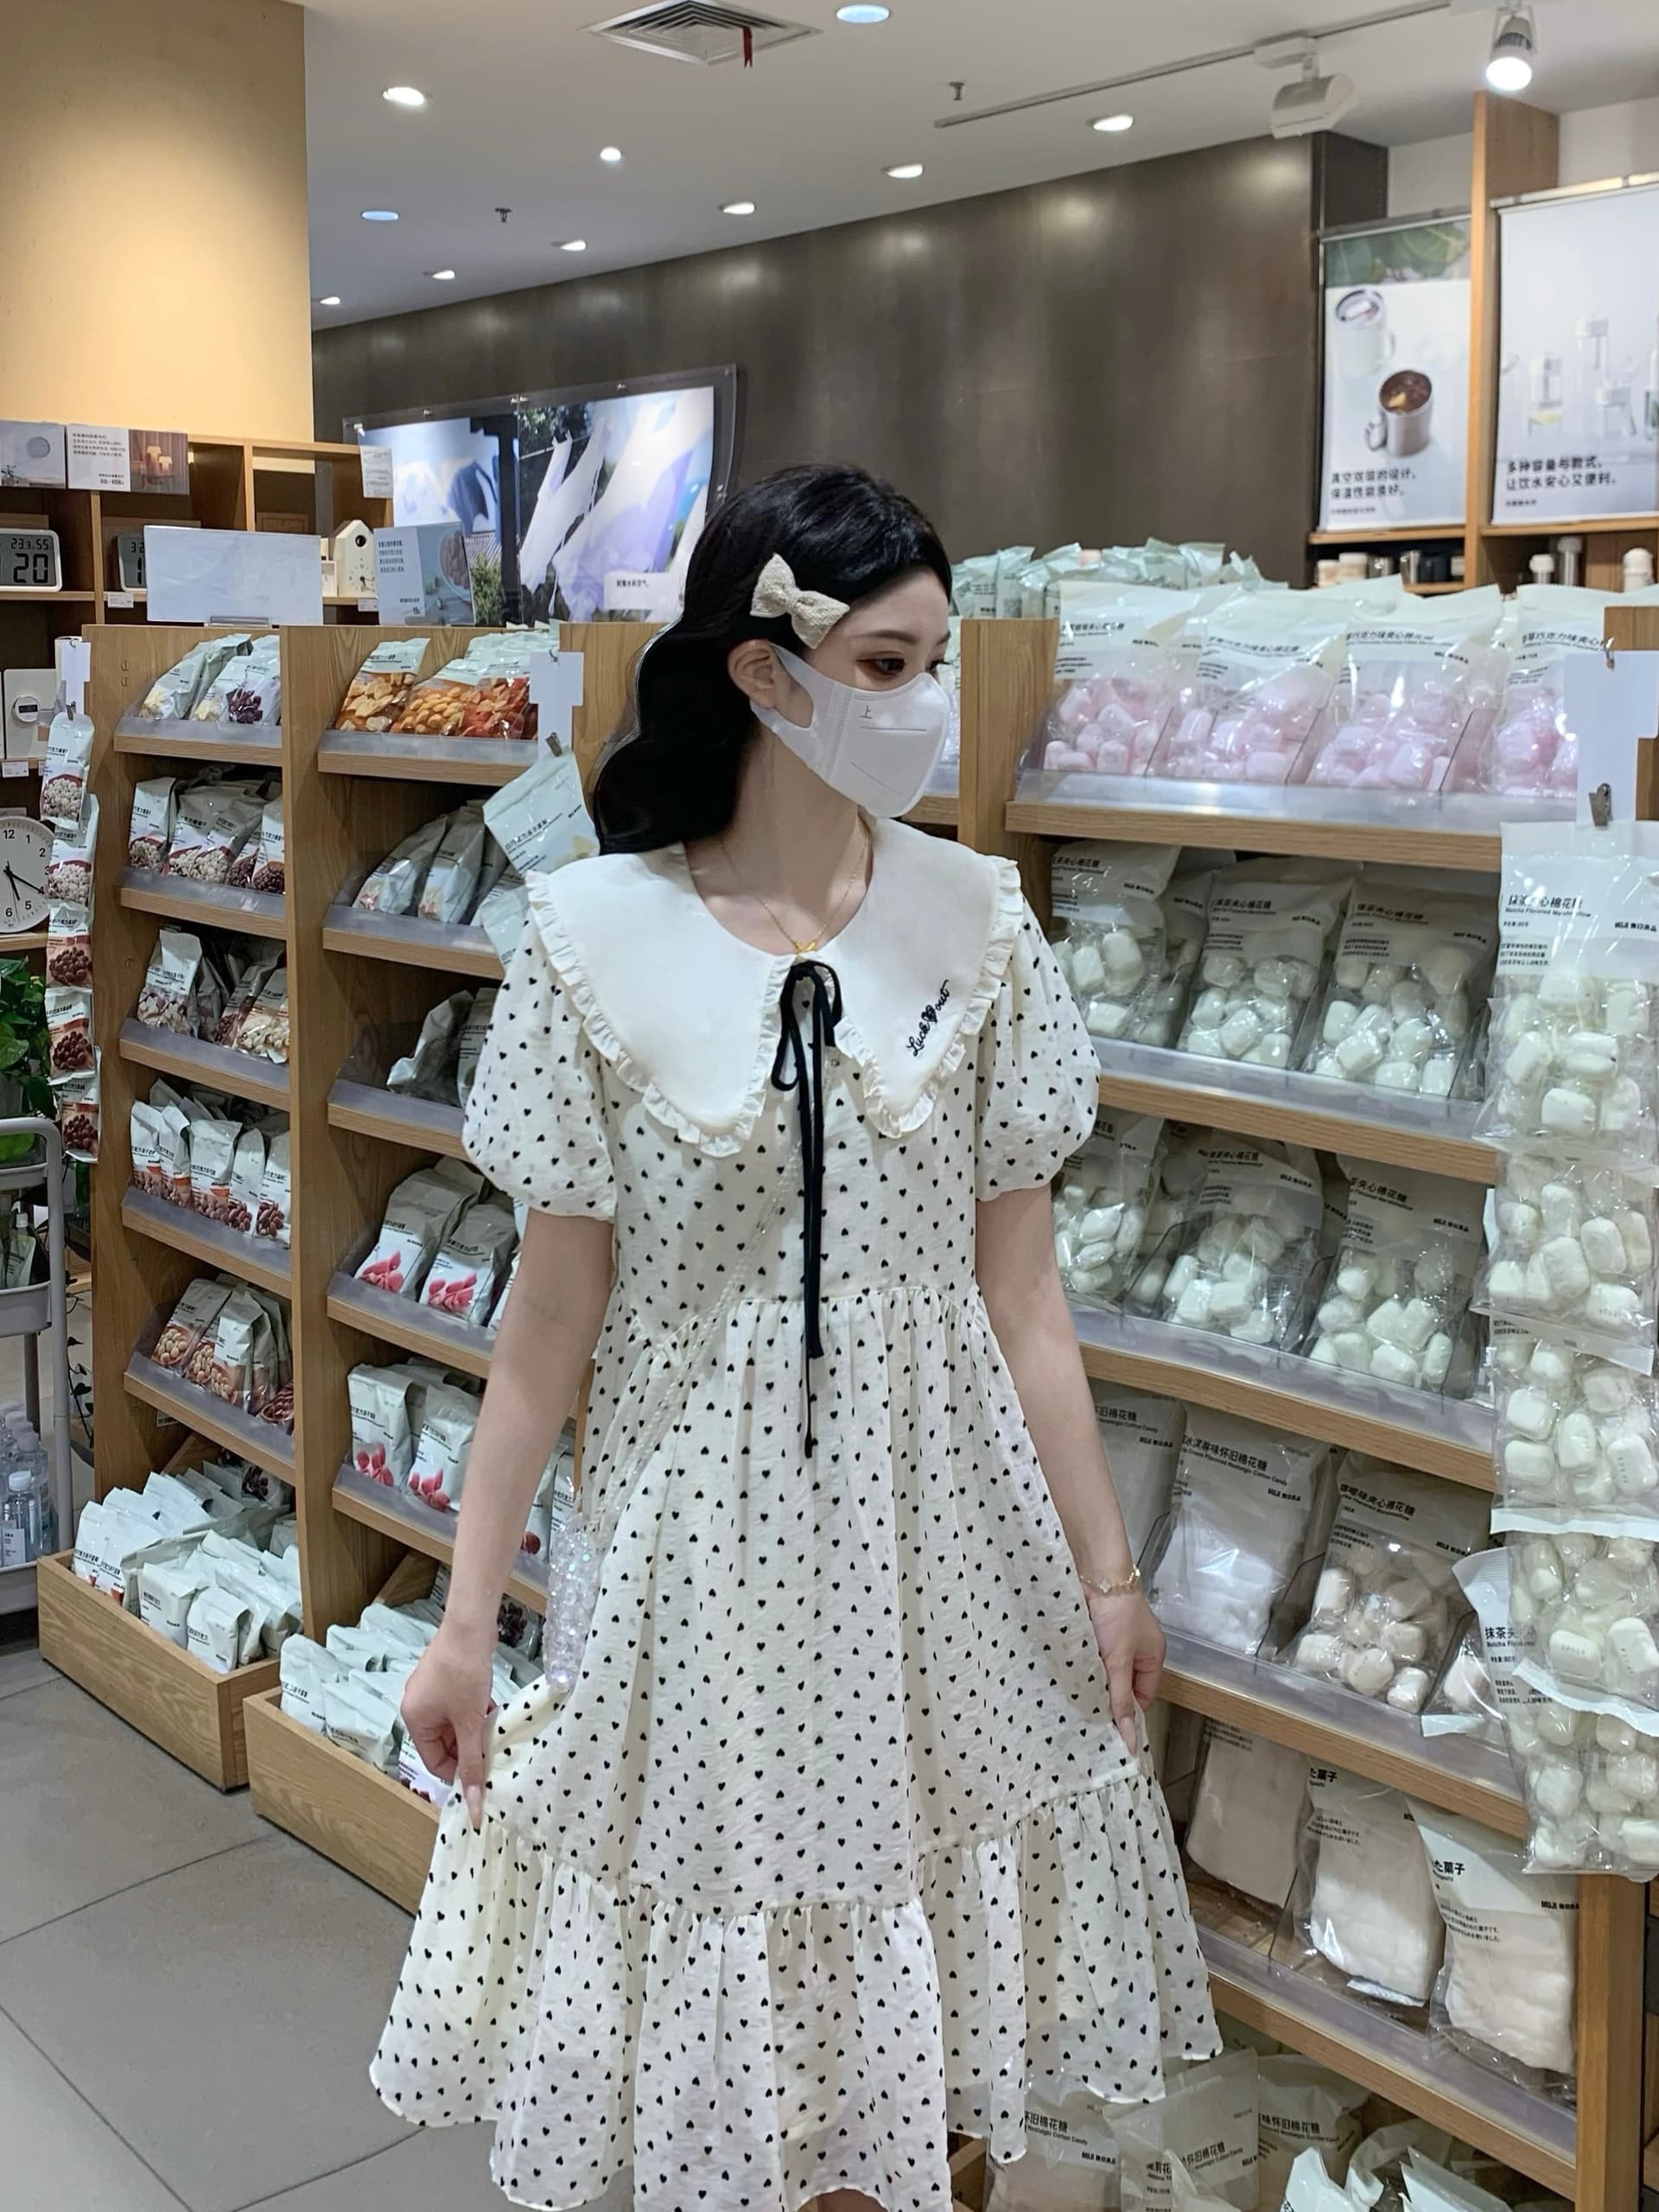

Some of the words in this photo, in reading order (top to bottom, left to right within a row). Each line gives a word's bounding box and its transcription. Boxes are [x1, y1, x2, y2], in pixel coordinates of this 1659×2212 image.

[3, 830, 15, 839] 12
[27, 835, 30, 843] 1
[39, 849, 46, 858] 2
[25, 901, 32, 910] 5
[5, 907, 12, 917] 6
